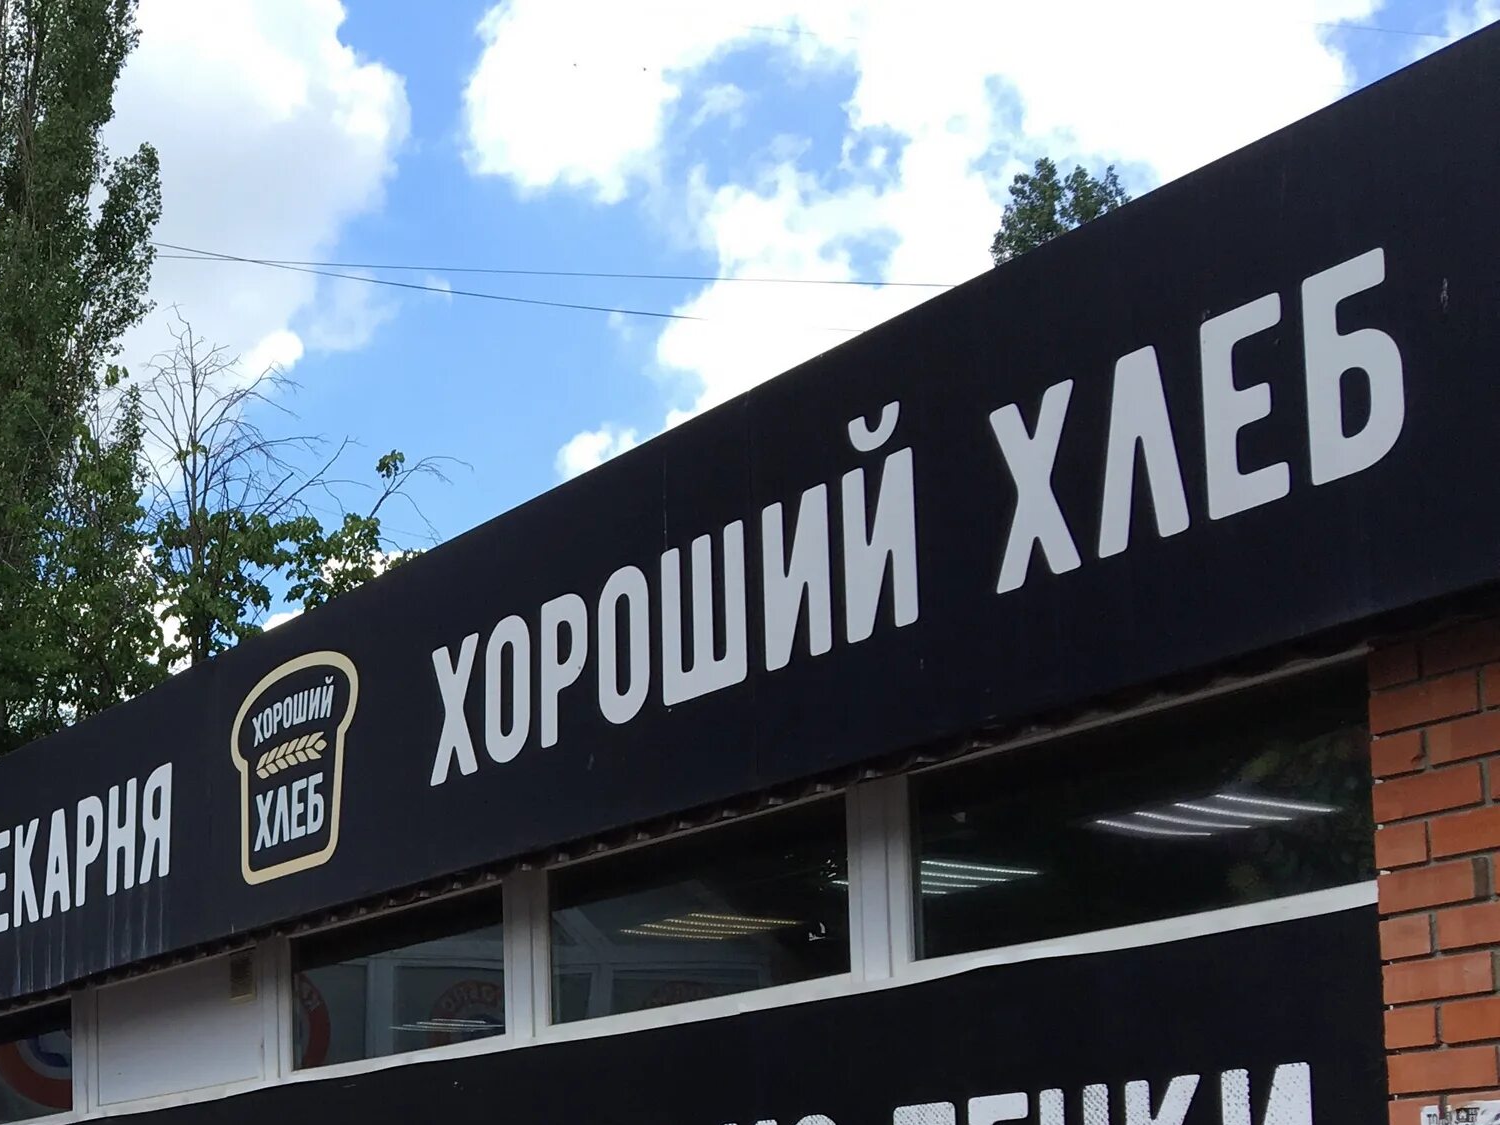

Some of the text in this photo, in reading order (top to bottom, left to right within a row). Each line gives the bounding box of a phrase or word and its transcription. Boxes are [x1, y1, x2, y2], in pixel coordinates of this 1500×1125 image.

[430, 246, 1405, 787] ХОРОШИЙ ХЛЕБ
[252, 675, 334, 748] ХОРОШИЙ
[254, 771, 325, 852] ХЛЕБ
